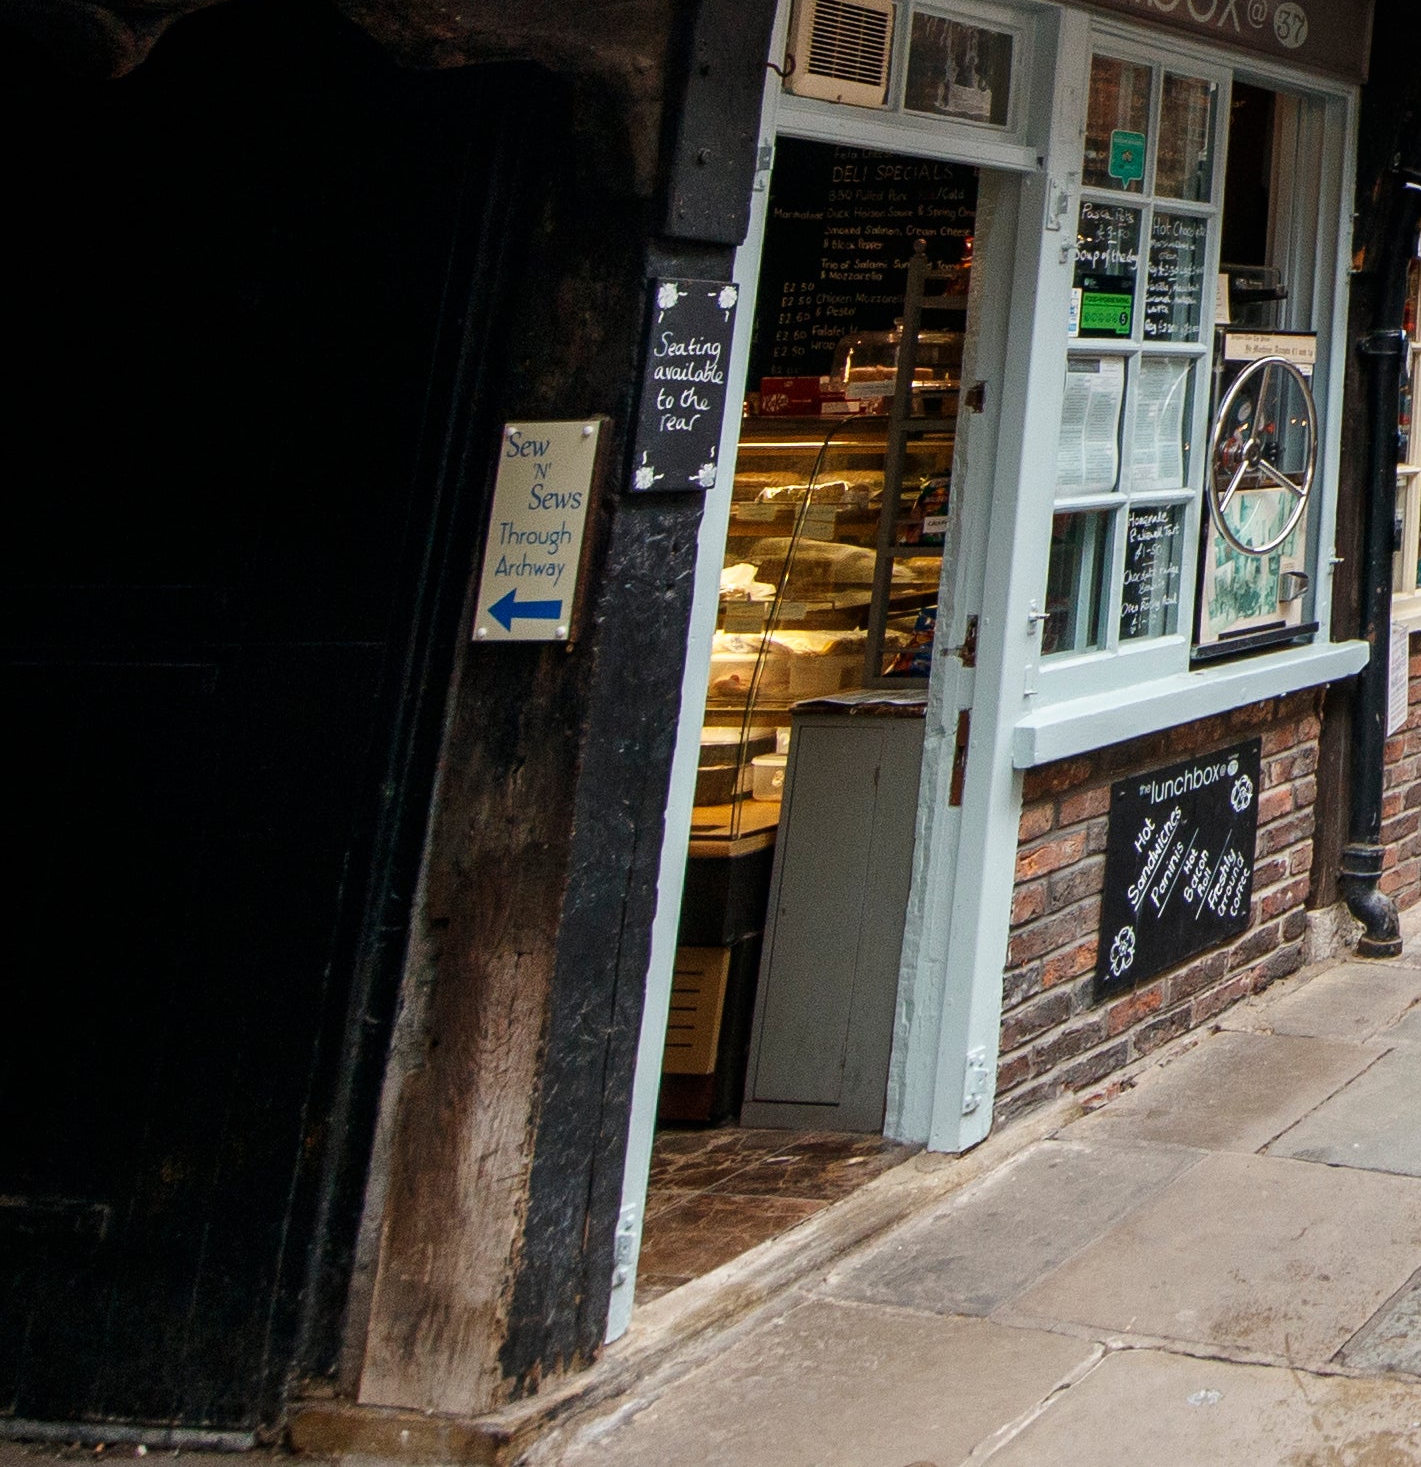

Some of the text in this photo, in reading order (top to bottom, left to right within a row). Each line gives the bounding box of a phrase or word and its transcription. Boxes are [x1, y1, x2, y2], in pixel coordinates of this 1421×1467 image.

[1277, 11, 1306, 43] 37
[832, 163, 953, 183] DELI SPECIALS
[654, 332, 721, 365] Seating
[654, 361, 724, 384] available
[656, 388, 710, 410] to the
[659, 414, 700, 432] rear
[506, 431, 549, 459] Sew
[529, 484, 582, 511] Sews
[500, 521, 571, 555] Through
[494, 555, 565, 586] Archway
[1151, 763, 1220, 804] lunchbox
[1134, 818, 1155, 852] Hot
[1128, 806, 1181, 904] Sandwiches
[1184, 849, 1198, 874] Hot
[1151, 842, 1184, 908] Paninis
[1184, 850, 1209, 902] Bacon
[1208, 848, 1236, 910] Freshly
